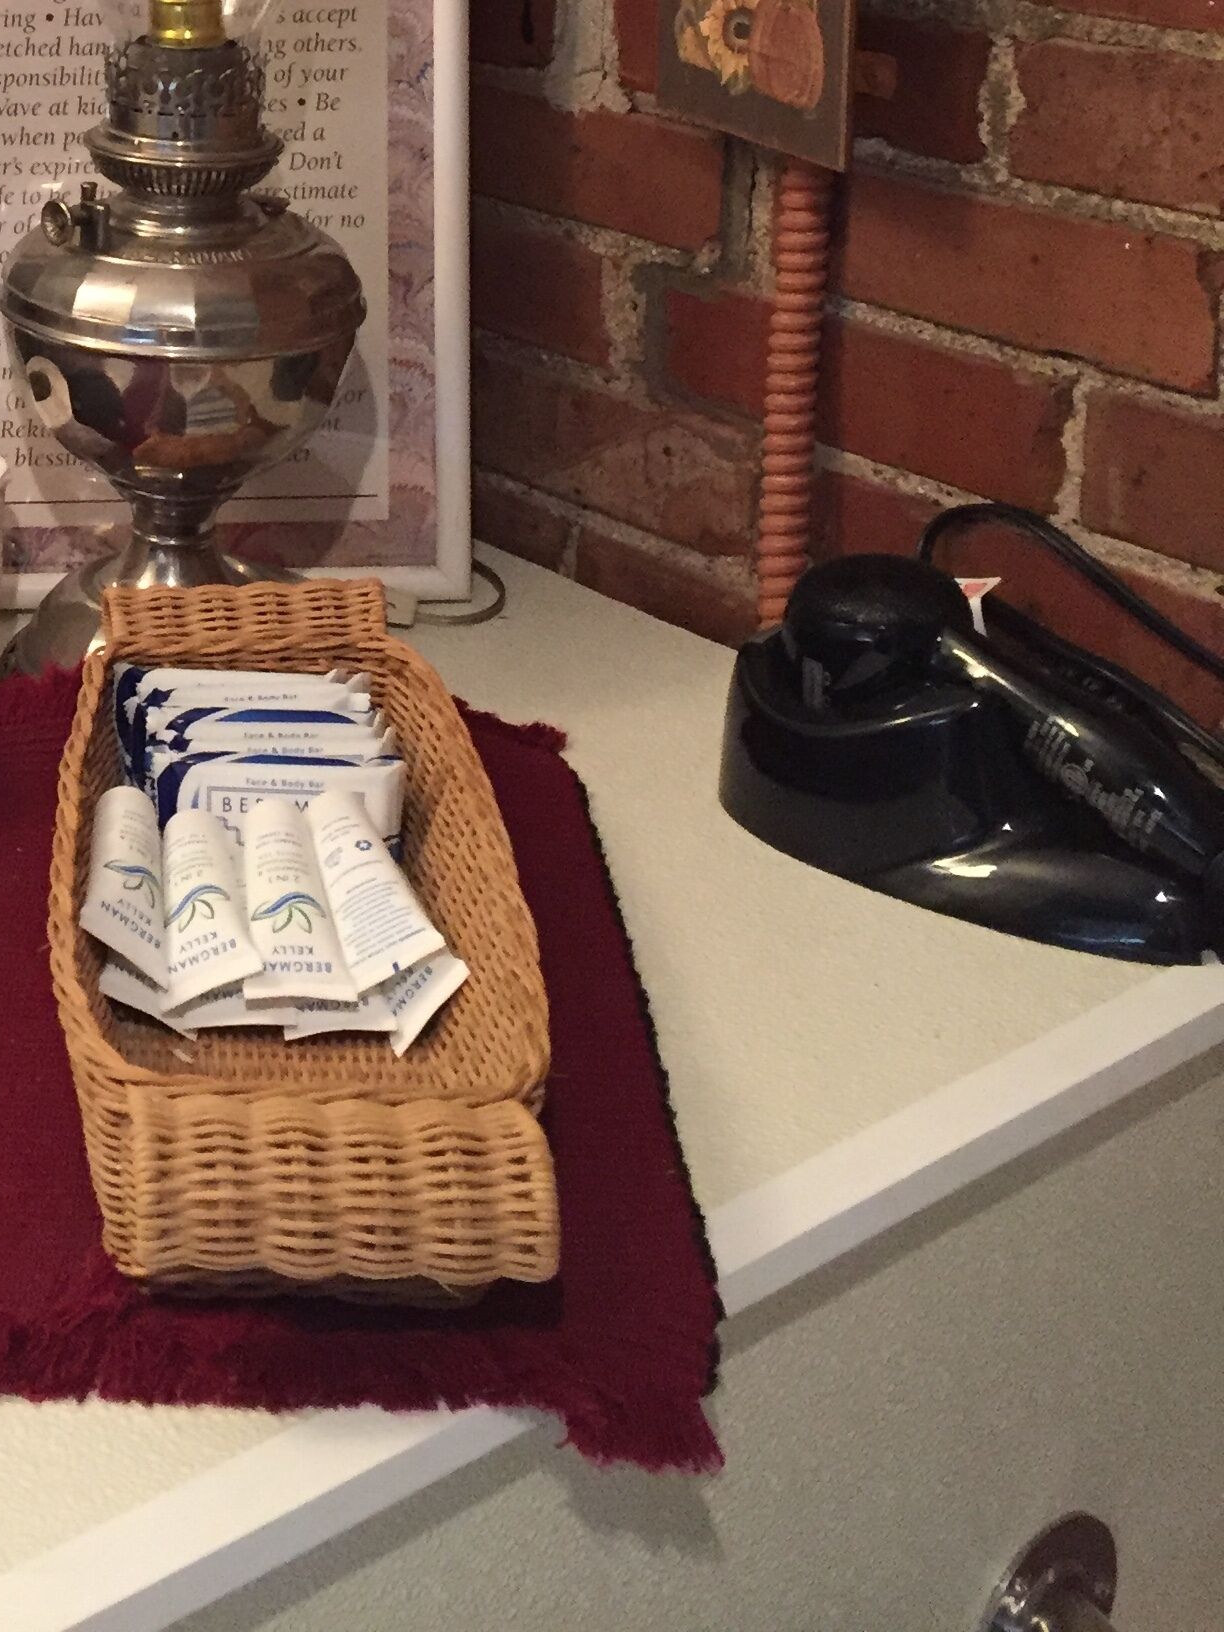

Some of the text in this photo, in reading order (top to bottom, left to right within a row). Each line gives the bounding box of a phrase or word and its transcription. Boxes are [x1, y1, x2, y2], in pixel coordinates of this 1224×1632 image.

[292, 7, 357, 29] accept
[300, 67, 346, 88] your
[0, 125, 56, 146] when
[100, 899, 162, 950] BERGMAN
[178, 930, 219, 954] KELLY
[271, 944, 315, 956] KELLY
[167, 937, 238, 974] BERGMAN
[390, 965, 434, 1017] BERGMA
